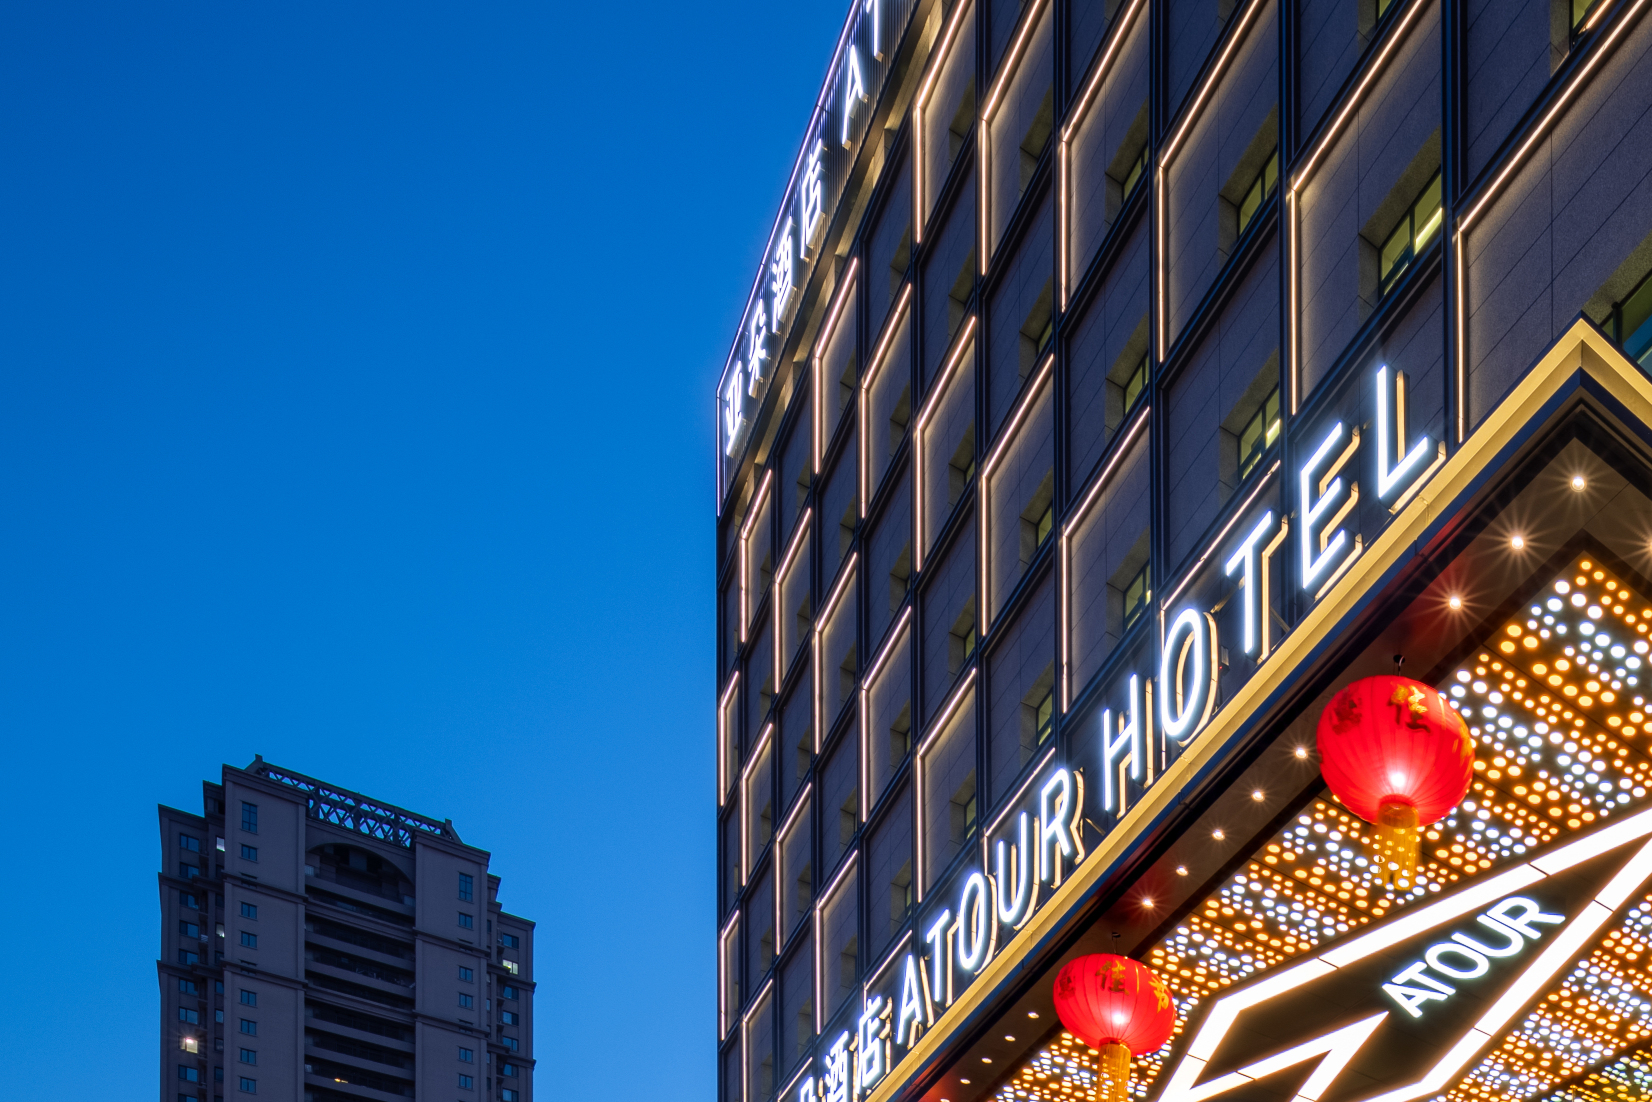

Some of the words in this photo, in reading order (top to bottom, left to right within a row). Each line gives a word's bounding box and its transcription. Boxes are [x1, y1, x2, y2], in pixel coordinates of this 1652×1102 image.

[726, 137, 823, 456] 亚朵酒店
[896, 767, 1072, 1045] ATOUR
[1103, 364, 1431, 811] HOTEL
[1381, 895, 1566, 1018] ATOUR
